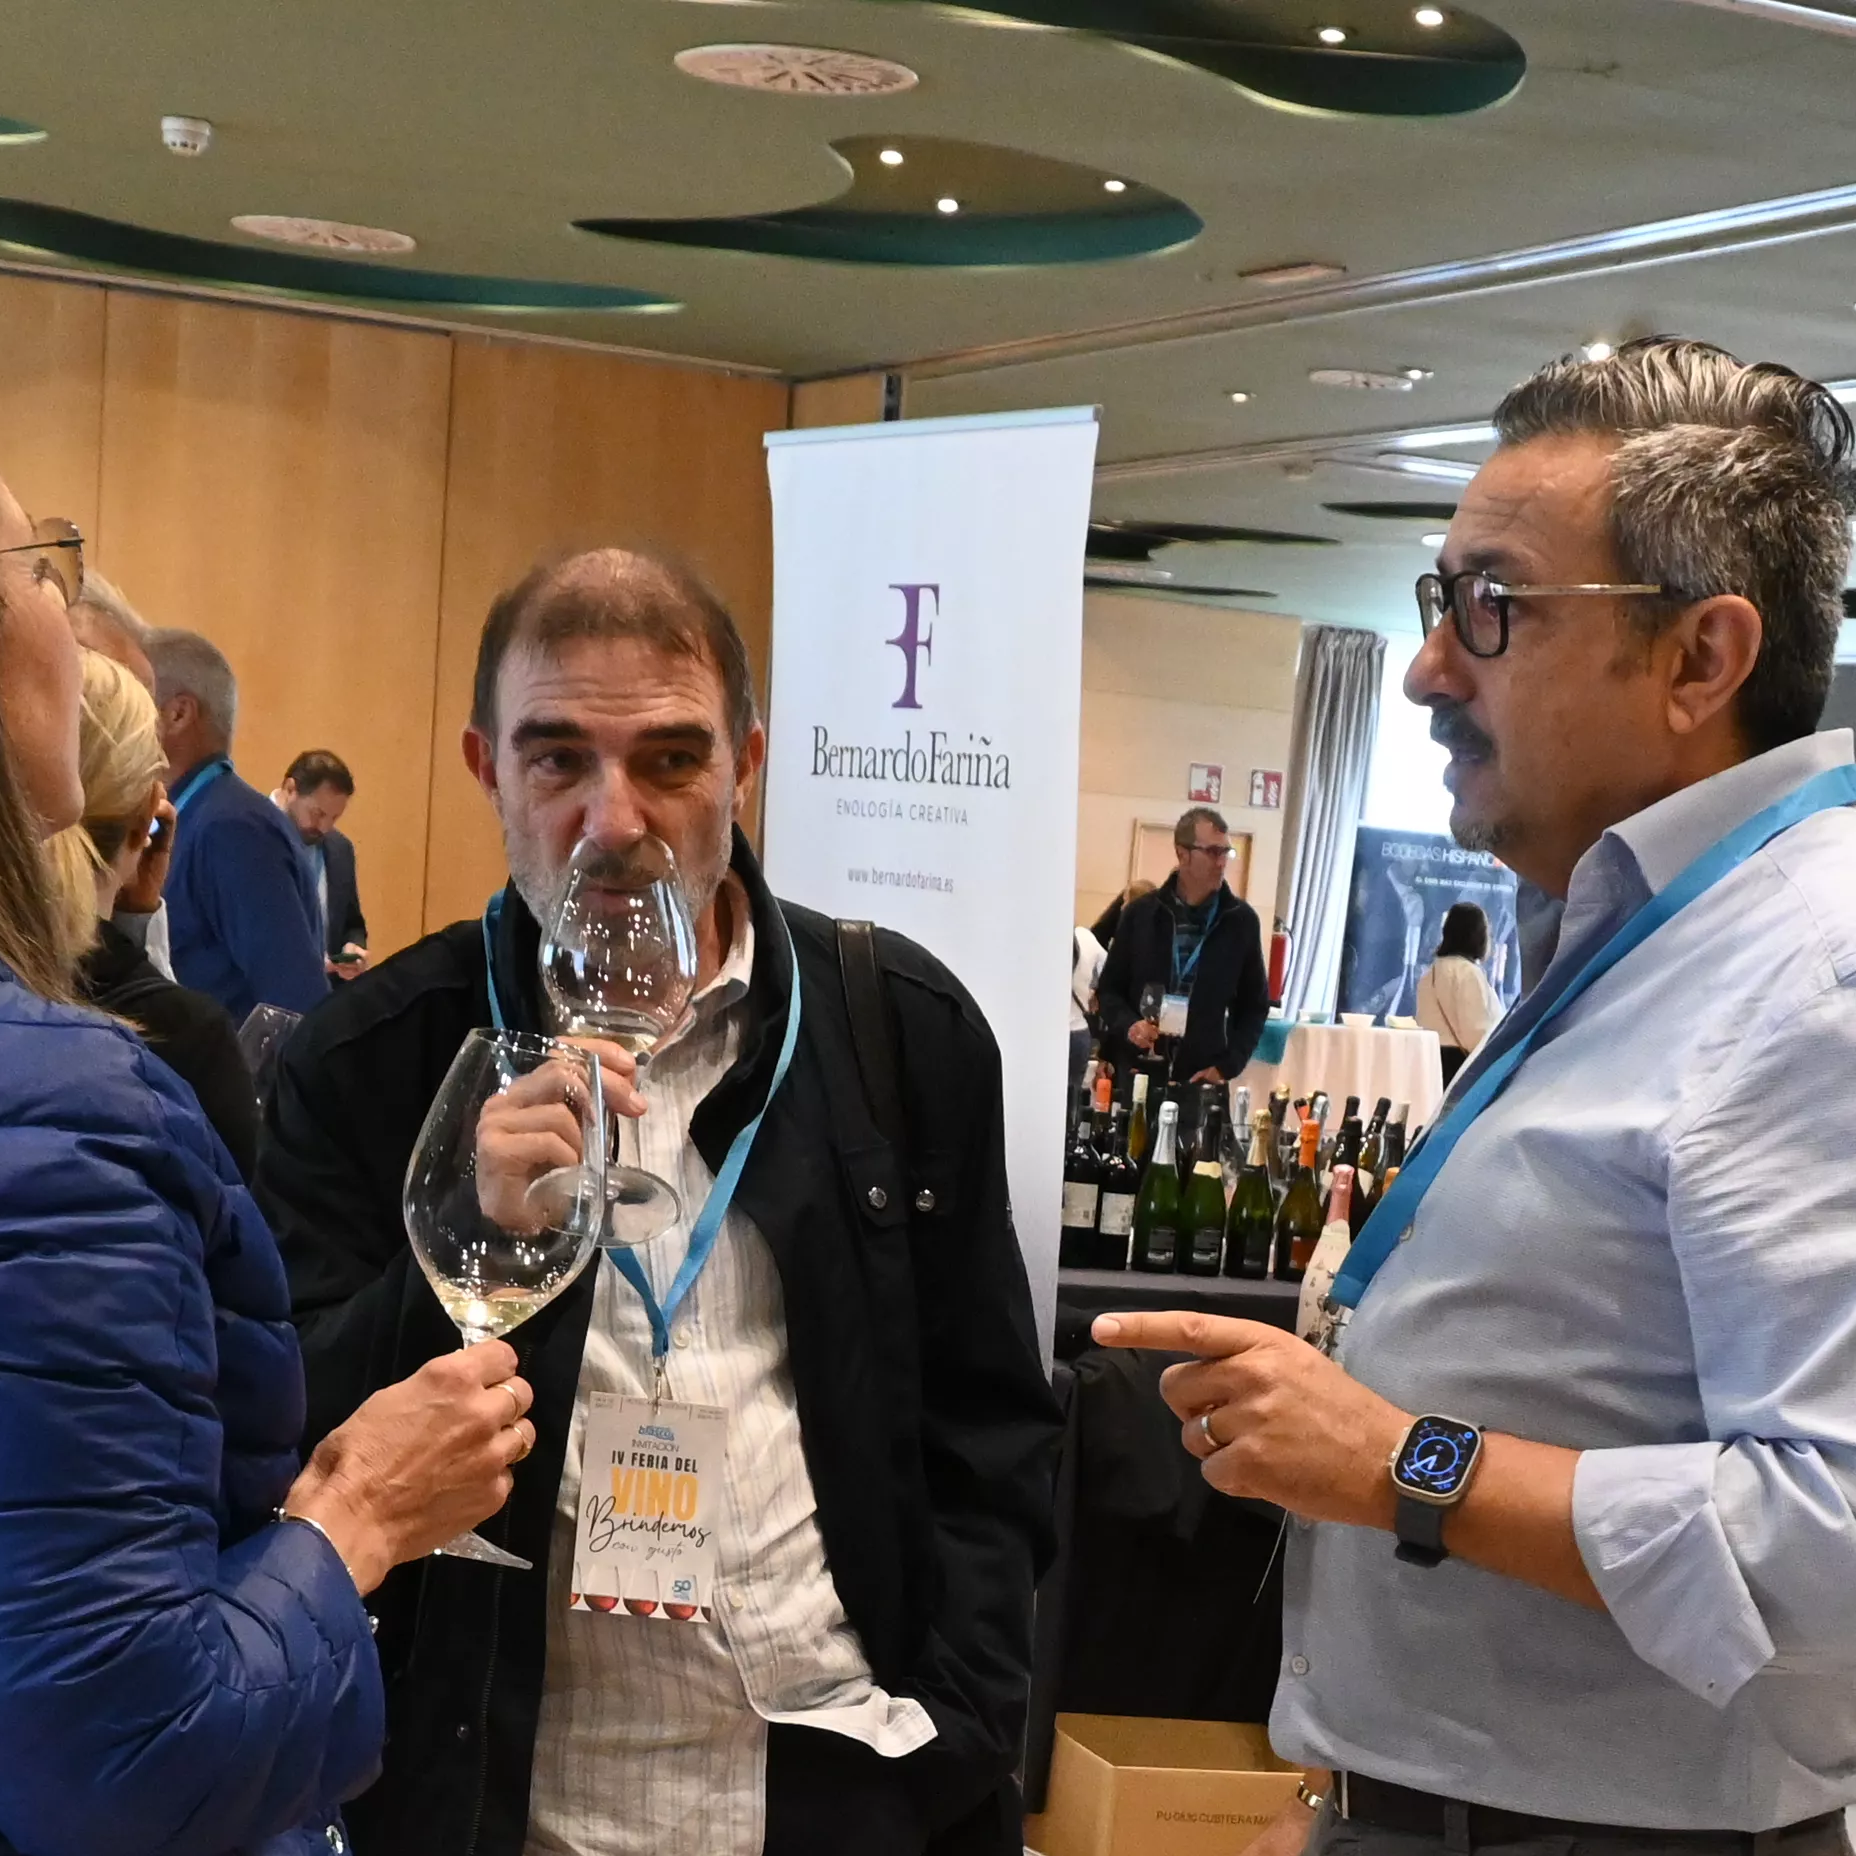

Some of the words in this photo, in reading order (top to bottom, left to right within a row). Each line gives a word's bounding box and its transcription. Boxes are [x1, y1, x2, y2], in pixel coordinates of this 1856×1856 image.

[810, 724, 1012, 790] BernardoFariña
[836, 798, 903, 820] ENOLOGÍA
[909, 804, 969, 826] CREATIVA
[611, 1450, 625, 1465] IV
[631, 1452, 668, 1470] FERIA
[675, 1458, 698, 1474] DEL
[610, 1466, 700, 1522] VINO
[585, 1494, 712, 1553] Brindemos
